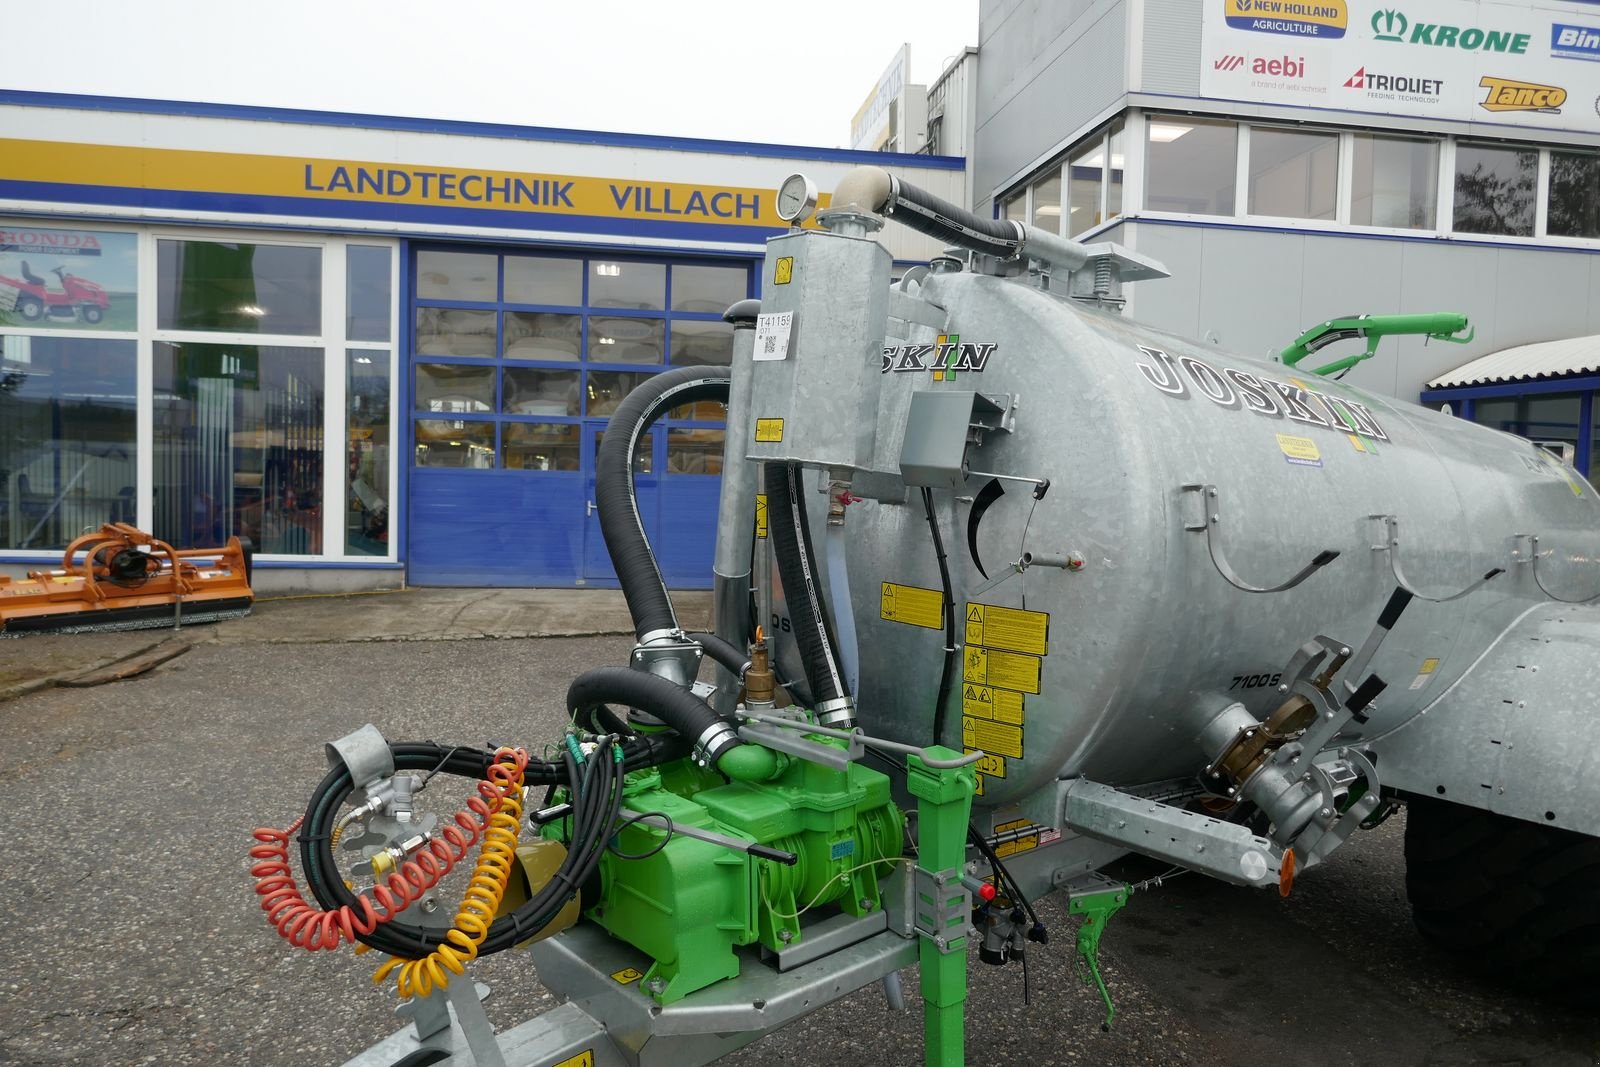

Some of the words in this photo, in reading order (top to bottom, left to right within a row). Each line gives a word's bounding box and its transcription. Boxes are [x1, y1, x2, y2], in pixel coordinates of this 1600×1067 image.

[1254, 1, 1282, 12] NEW
[1284, 3, 1338, 18] HOLLAND
[1252, 19, 1318, 35] AGRICULTURE
[1409, 23, 1531, 54] KRONE
[1557, 28, 1600, 49] Bin
[1252, 56, 1304, 78] aebi
[1257, 80, 1276, 89] brand
[1278, 82, 1284, 90] of
[1286, 82, 1299, 91] aebi
[1301, 84, 1327, 94] schmidt
[1365, 73, 1443, 95] TRIOLIET
[1479, 76, 1567, 108] Tanco
[1367, 91, 1395, 100] FEEDING
[1398, 95, 1440, 104] TECHNOLOGY
[304, 163, 575, 208] LANDTECHNIK
[609, 184, 760, 220] VILLACH
[0, 230, 102, 249] HONDA
[1136, 344, 1390, 443] JOSKIN
[1229, 673, 1282, 690] 7100S
